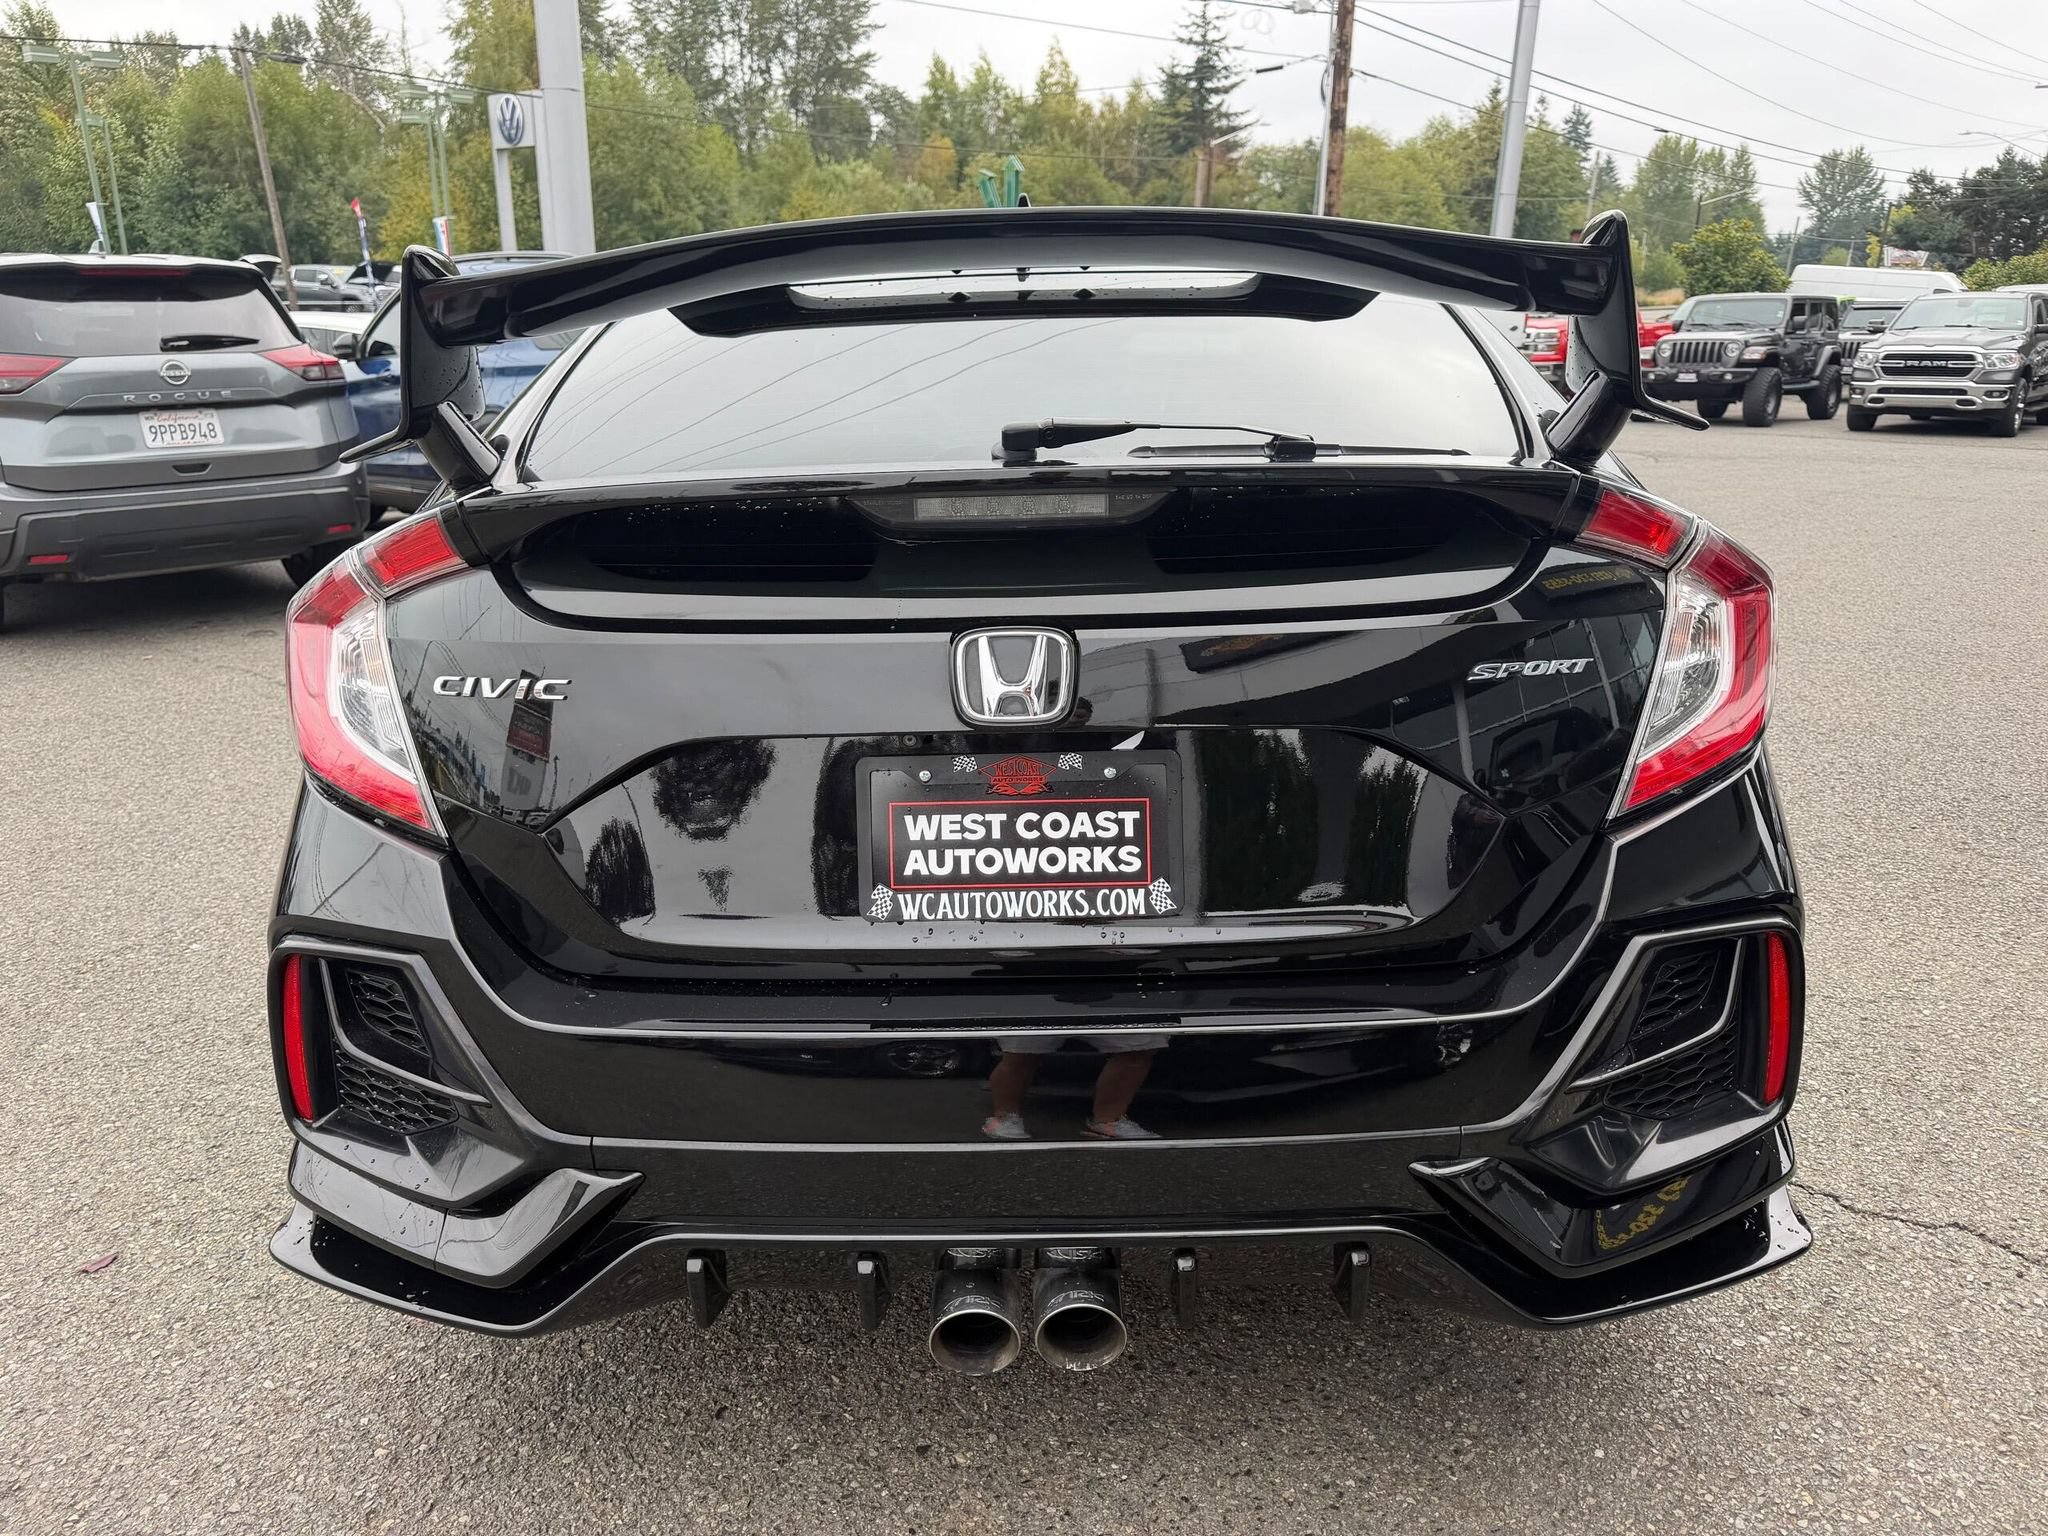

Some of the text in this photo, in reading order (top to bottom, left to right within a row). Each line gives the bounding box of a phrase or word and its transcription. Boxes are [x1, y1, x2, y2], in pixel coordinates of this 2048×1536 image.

[123, 390, 232, 403] ROGUE
[148, 422, 218, 442] 9PPB948
[1467, 657, 1594, 681] SPORT
[433, 675, 572, 700] CIVIC
[904, 811, 1140, 841] WEST COAST
[903, 845, 1142, 875] AUTOWORKS
[897, 888, 1146, 920] WCAUTOWORKS.COM
